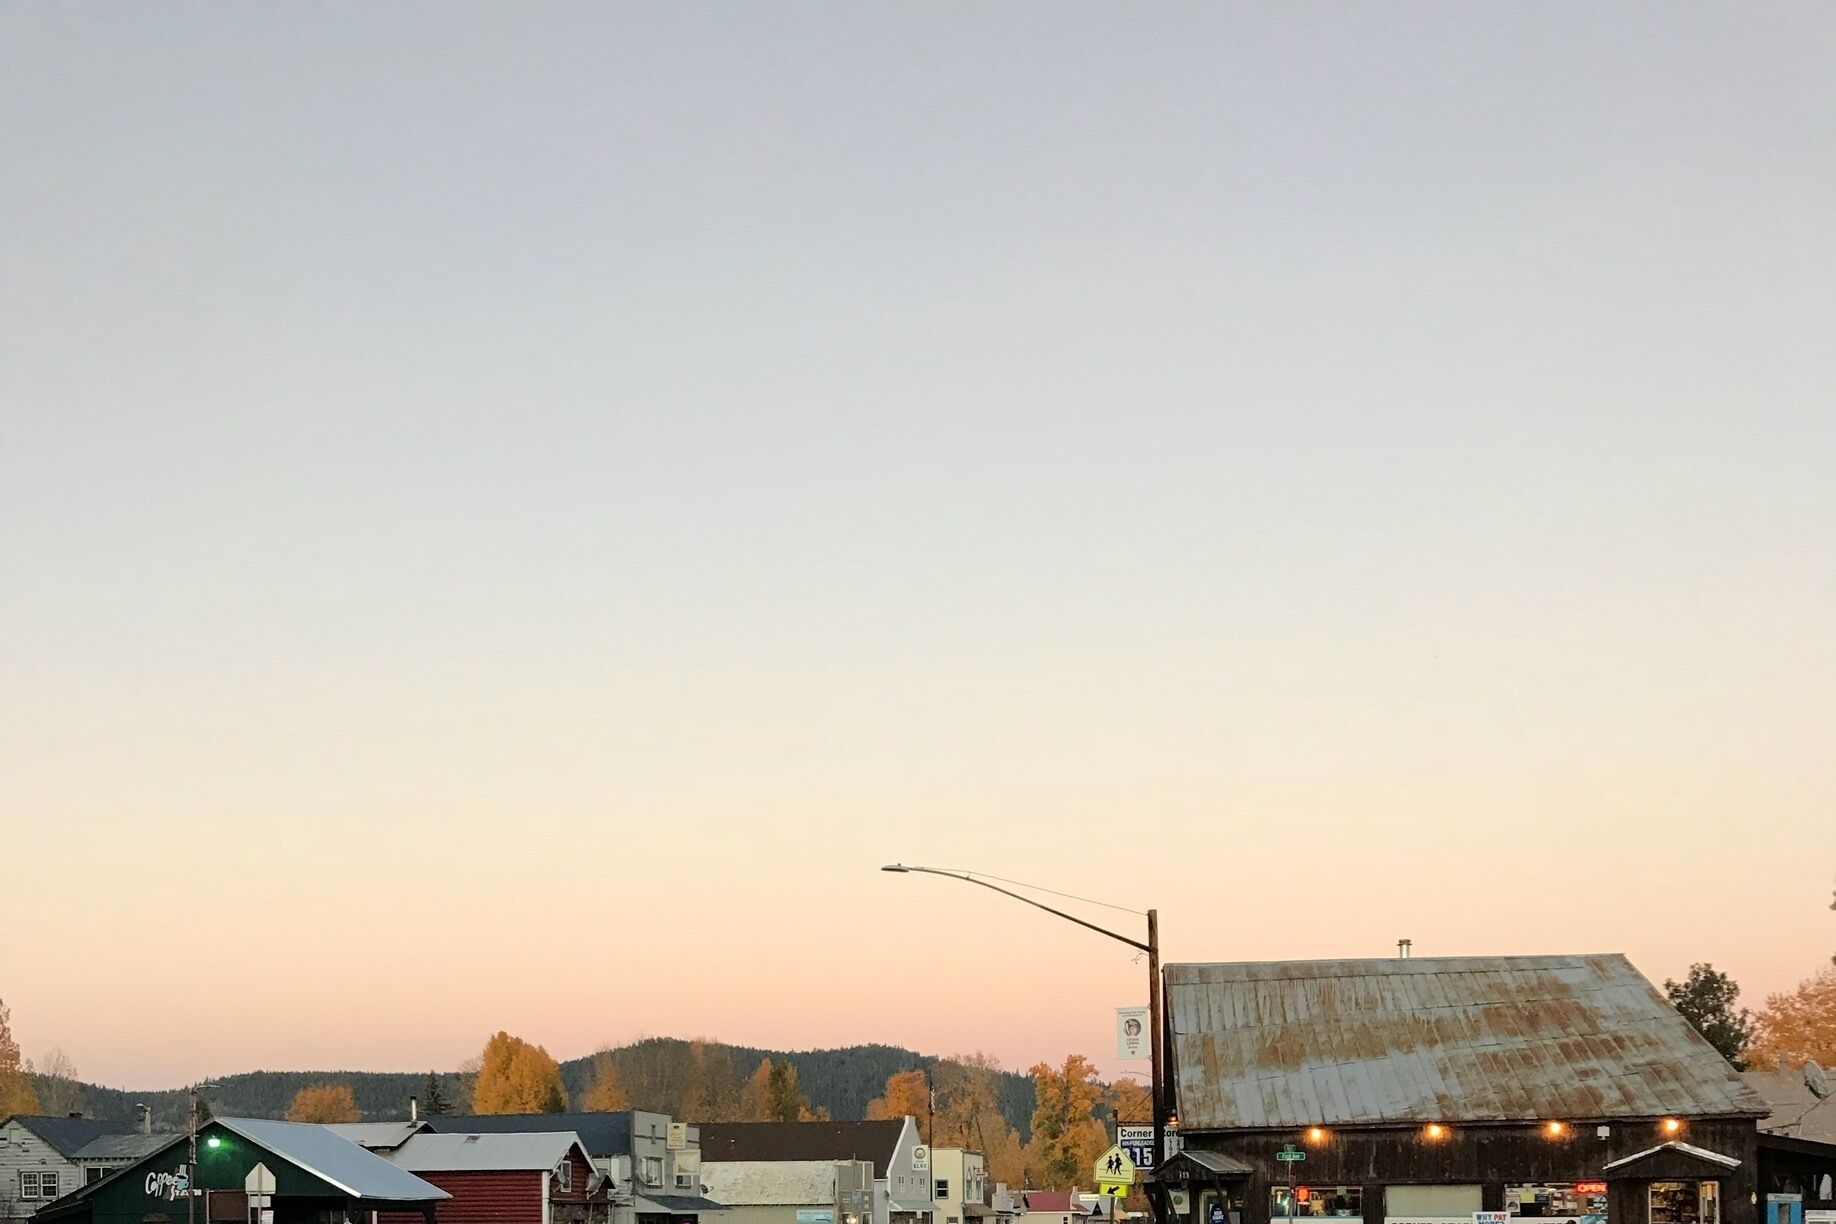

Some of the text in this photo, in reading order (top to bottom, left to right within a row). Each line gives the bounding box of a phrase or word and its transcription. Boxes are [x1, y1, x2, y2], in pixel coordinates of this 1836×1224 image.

[1121, 1129, 1152, 1137] Corner
[145, 1172, 179, 1197] Coffee
[1578, 1184, 1607, 1193] OPEN
